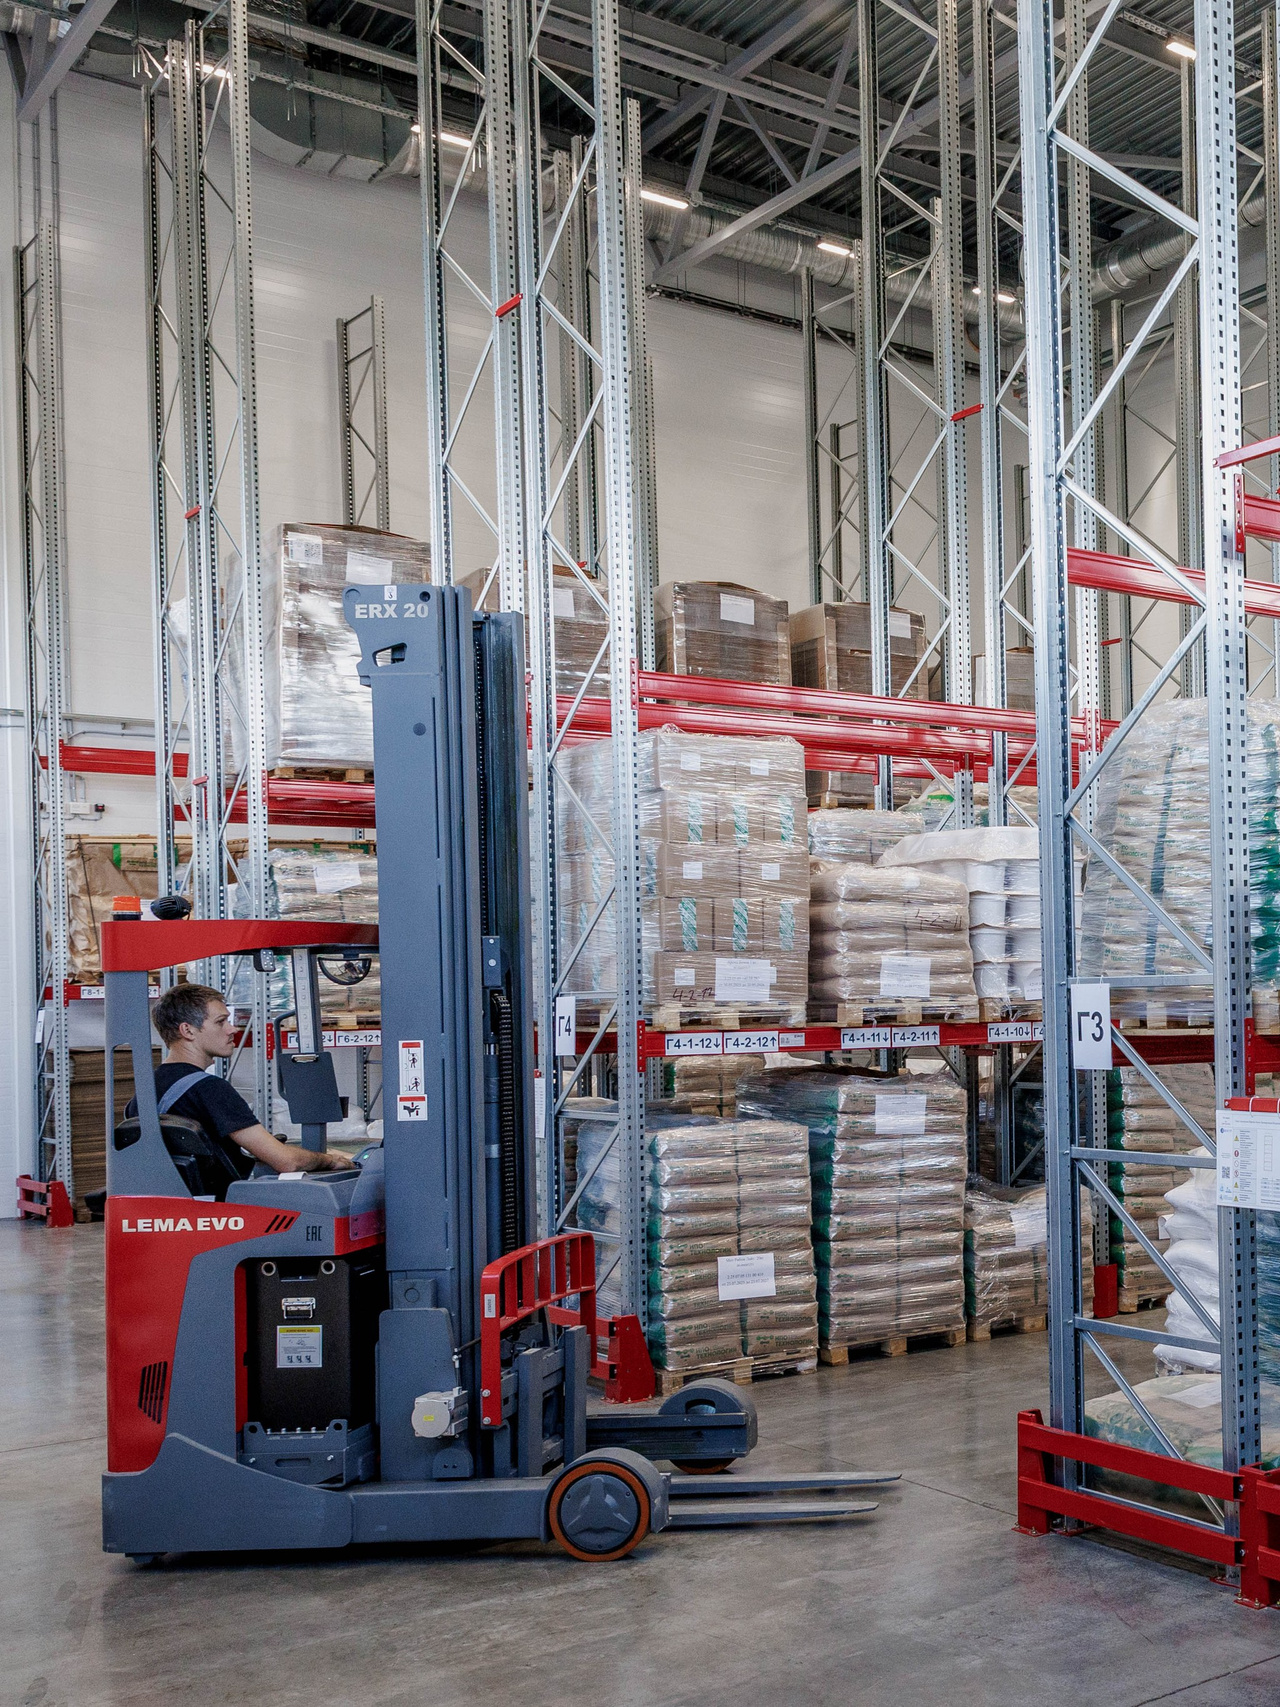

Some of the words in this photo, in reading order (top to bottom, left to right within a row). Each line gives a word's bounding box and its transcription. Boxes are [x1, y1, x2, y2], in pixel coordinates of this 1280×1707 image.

[355, 603, 398, 619] ERX
[403, 603, 429, 618] 20
[558, 1015, 572, 1037] Г4
[988, 1026, 1024, 1038] Г4-1-10
[1077, 1011, 1104, 1042] Г3
[337, 1034, 374, 1044] Г6-2-12
[666, 1037, 713, 1050] Г4-1-12
[725, 1036, 769, 1049] Г4-2-12
[842, 1032, 881, 1044] Г4-1-11
[893, 1031, 930, 1043] Г4-2-11
[122, 1218, 193, 1233] LEMA
[197, 1217, 245, 1231] EVO
[306, 1225, 322, 1241] EAC
